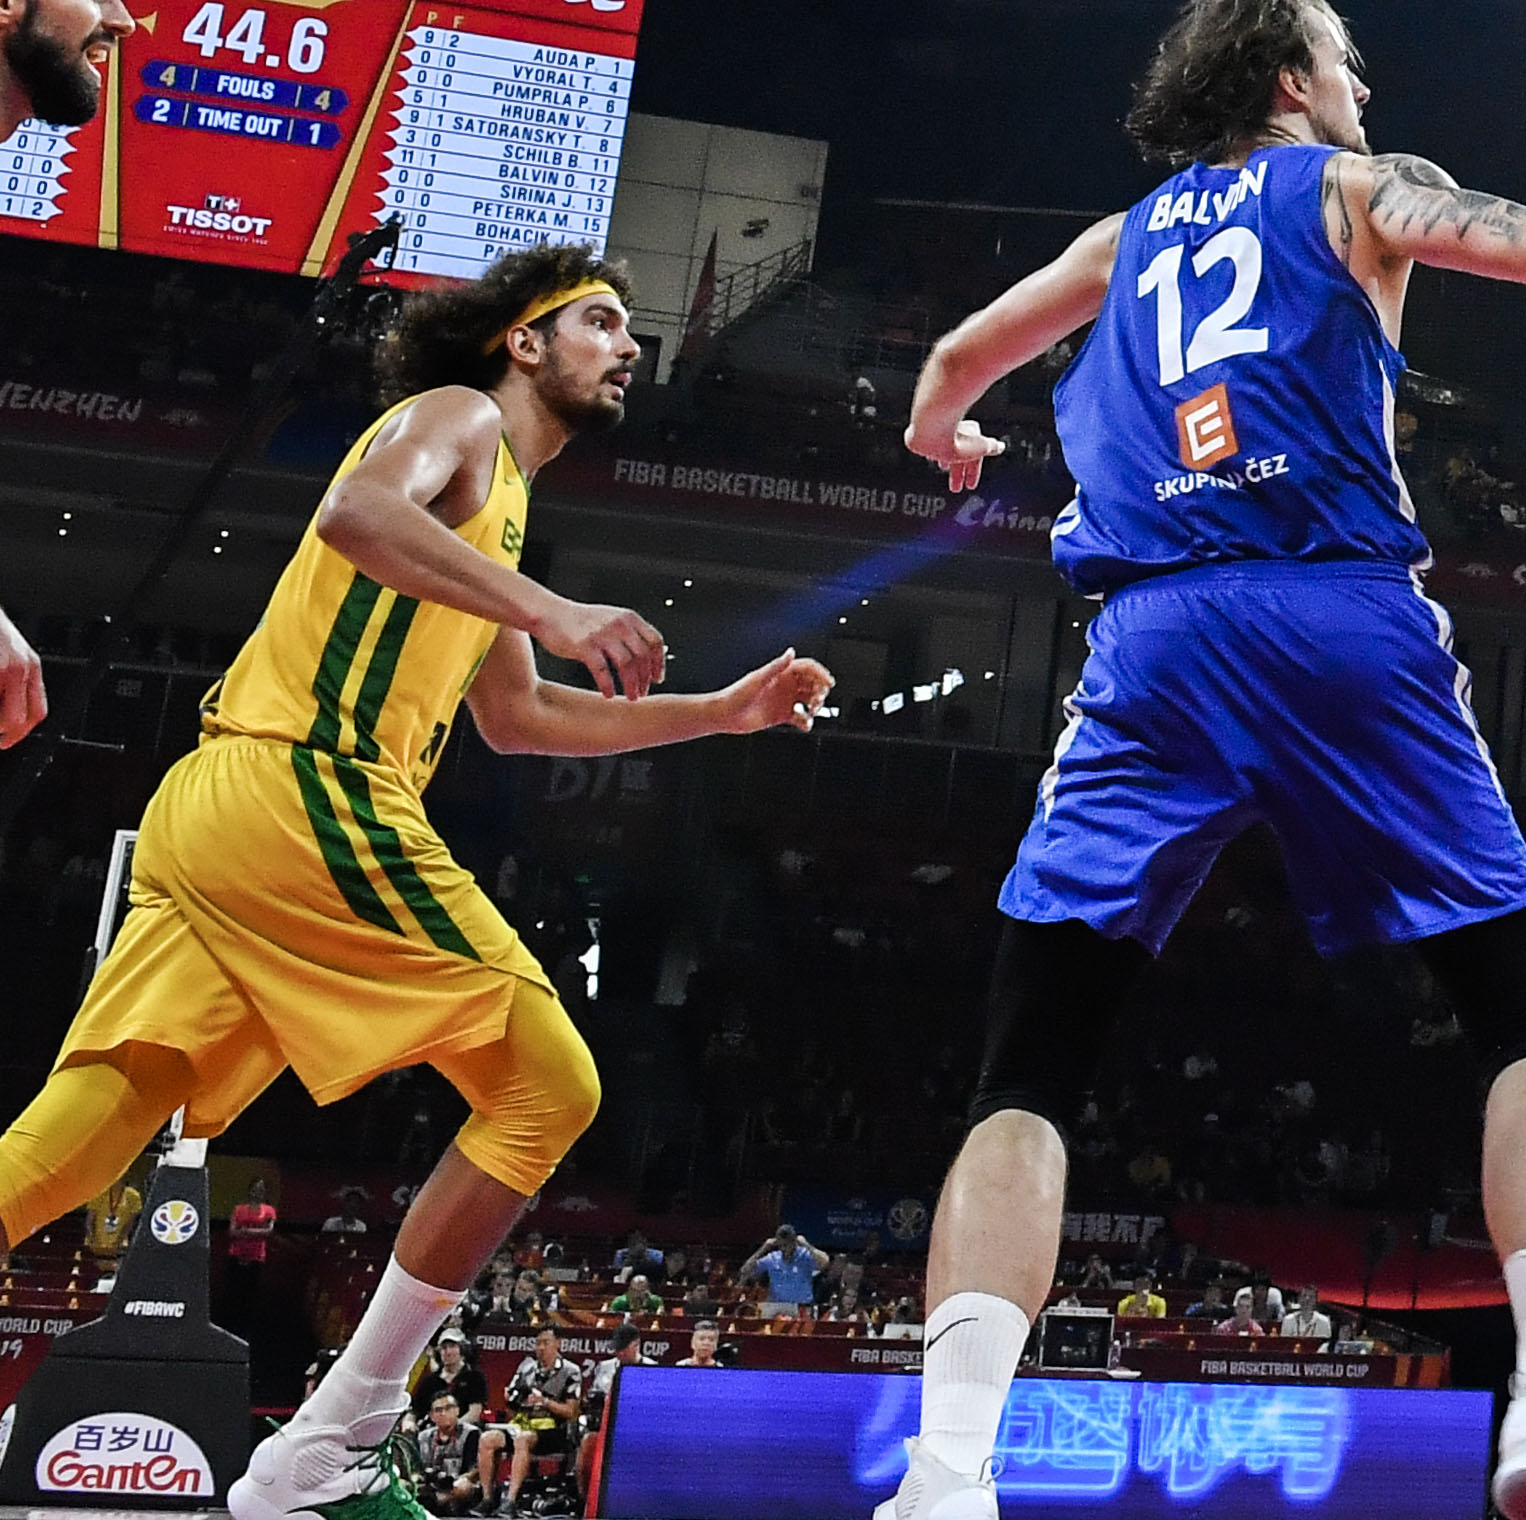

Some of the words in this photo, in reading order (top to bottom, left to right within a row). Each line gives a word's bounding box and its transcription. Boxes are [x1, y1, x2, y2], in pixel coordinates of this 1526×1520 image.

[426, 11, 438, 25] P
[453, 15, 464, 28] F
[182, 2, 328, 73] 44.6
[425, 30, 435, 44] 9
[449, 34, 460, 48] 2
[533, 48, 579, 68] AUDA
[613, 61, 621, 74] 1
[420, 50, 431, 64] 0
[445, 54, 456, 68] 0
[513, 64, 576, 88] VYORAL
[608, 80, 618, 94] 4
[159, 66, 176, 87] 4
[216, 75, 276, 100] FOULS
[314, 90, 331, 111] 4
[416, 70, 427, 83] 0
[442, 74, 453, 87] 0
[492, 81, 572, 107] PUMPRLA
[605, 100, 615, 114] 6
[152, 99, 171, 123] 2
[197, 107, 243, 132] TIME
[244, 115, 283, 138] OUT
[309, 123, 322, 145] 1
[413, 90, 423, 103] 5
[440, 94, 448, 107] 1
[500, 103, 570, 127] HRUBAN
[603, 120, 613, 133] 7
[17, 134, 28, 149] 0
[48, 139, 57, 152] 7
[410, 110, 420, 124] 9
[436, 114, 444, 127] 1
[452, 116, 566, 149] SATORANSKY
[599, 139, 609, 153] 8
[12, 155, 23, 170] 0
[41, 160, 52, 174] 0
[405, 130, 415, 143] 3
[431, 134, 441, 147] 0
[503, 144, 562, 166] SCHILB
[593, 158, 609, 172] 11
[8, 176, 18, 191] 0
[36, 180, 48, 195] 0
[400, 149, 414, 164] 11
[429, 153, 437, 167] 1
[499, 164, 559, 186] BALVIN
[590, 178, 607, 193] 12
[398, 170, 409, 183] 0
[423, 173, 434, 187] 0
[500, 184, 556, 206] SIRINA
[586, 198, 604, 213] 13
[5, 198, 13, 212] 1
[32, 202, 43, 216] 2
[167, 205, 272, 236] TISSOT
[394, 189, 405, 203] 0
[420, 193, 430, 208] 0
[473, 200, 547, 225] PETERKA
[583, 217, 601, 232] 15
[416, 214, 427, 228] 0
[412, 234, 423, 249] 0
[410, 255, 418, 269] 1
[1137, 226, 1269, 387] 12
[1245, 453, 1290, 483] ČEZ
[614, 457, 665, 489] FIBA
[671, 464, 814, 504] BASKETBALL
[817, 481, 898, 514] WORLD
[902, 491, 946, 519] CUP
[123, 1300, 187, 1318] #FIBAWC
[43, 1318, 73, 1335] CUP
[508, 1336, 592, 1353] BASBALL
[642, 1341, 670, 1356] CUP
[851, 1348, 879, 1363] FIBA
[1201, 1360, 1227, 1374] FIBA
[1230, 1361, 1301, 1376] BASKETBALL
[1304, 1363, 1344, 1377] WORLD
[1346, 1364, 1369, 1378] CUP
[74, 1425, 174, 1453] 百岁山
